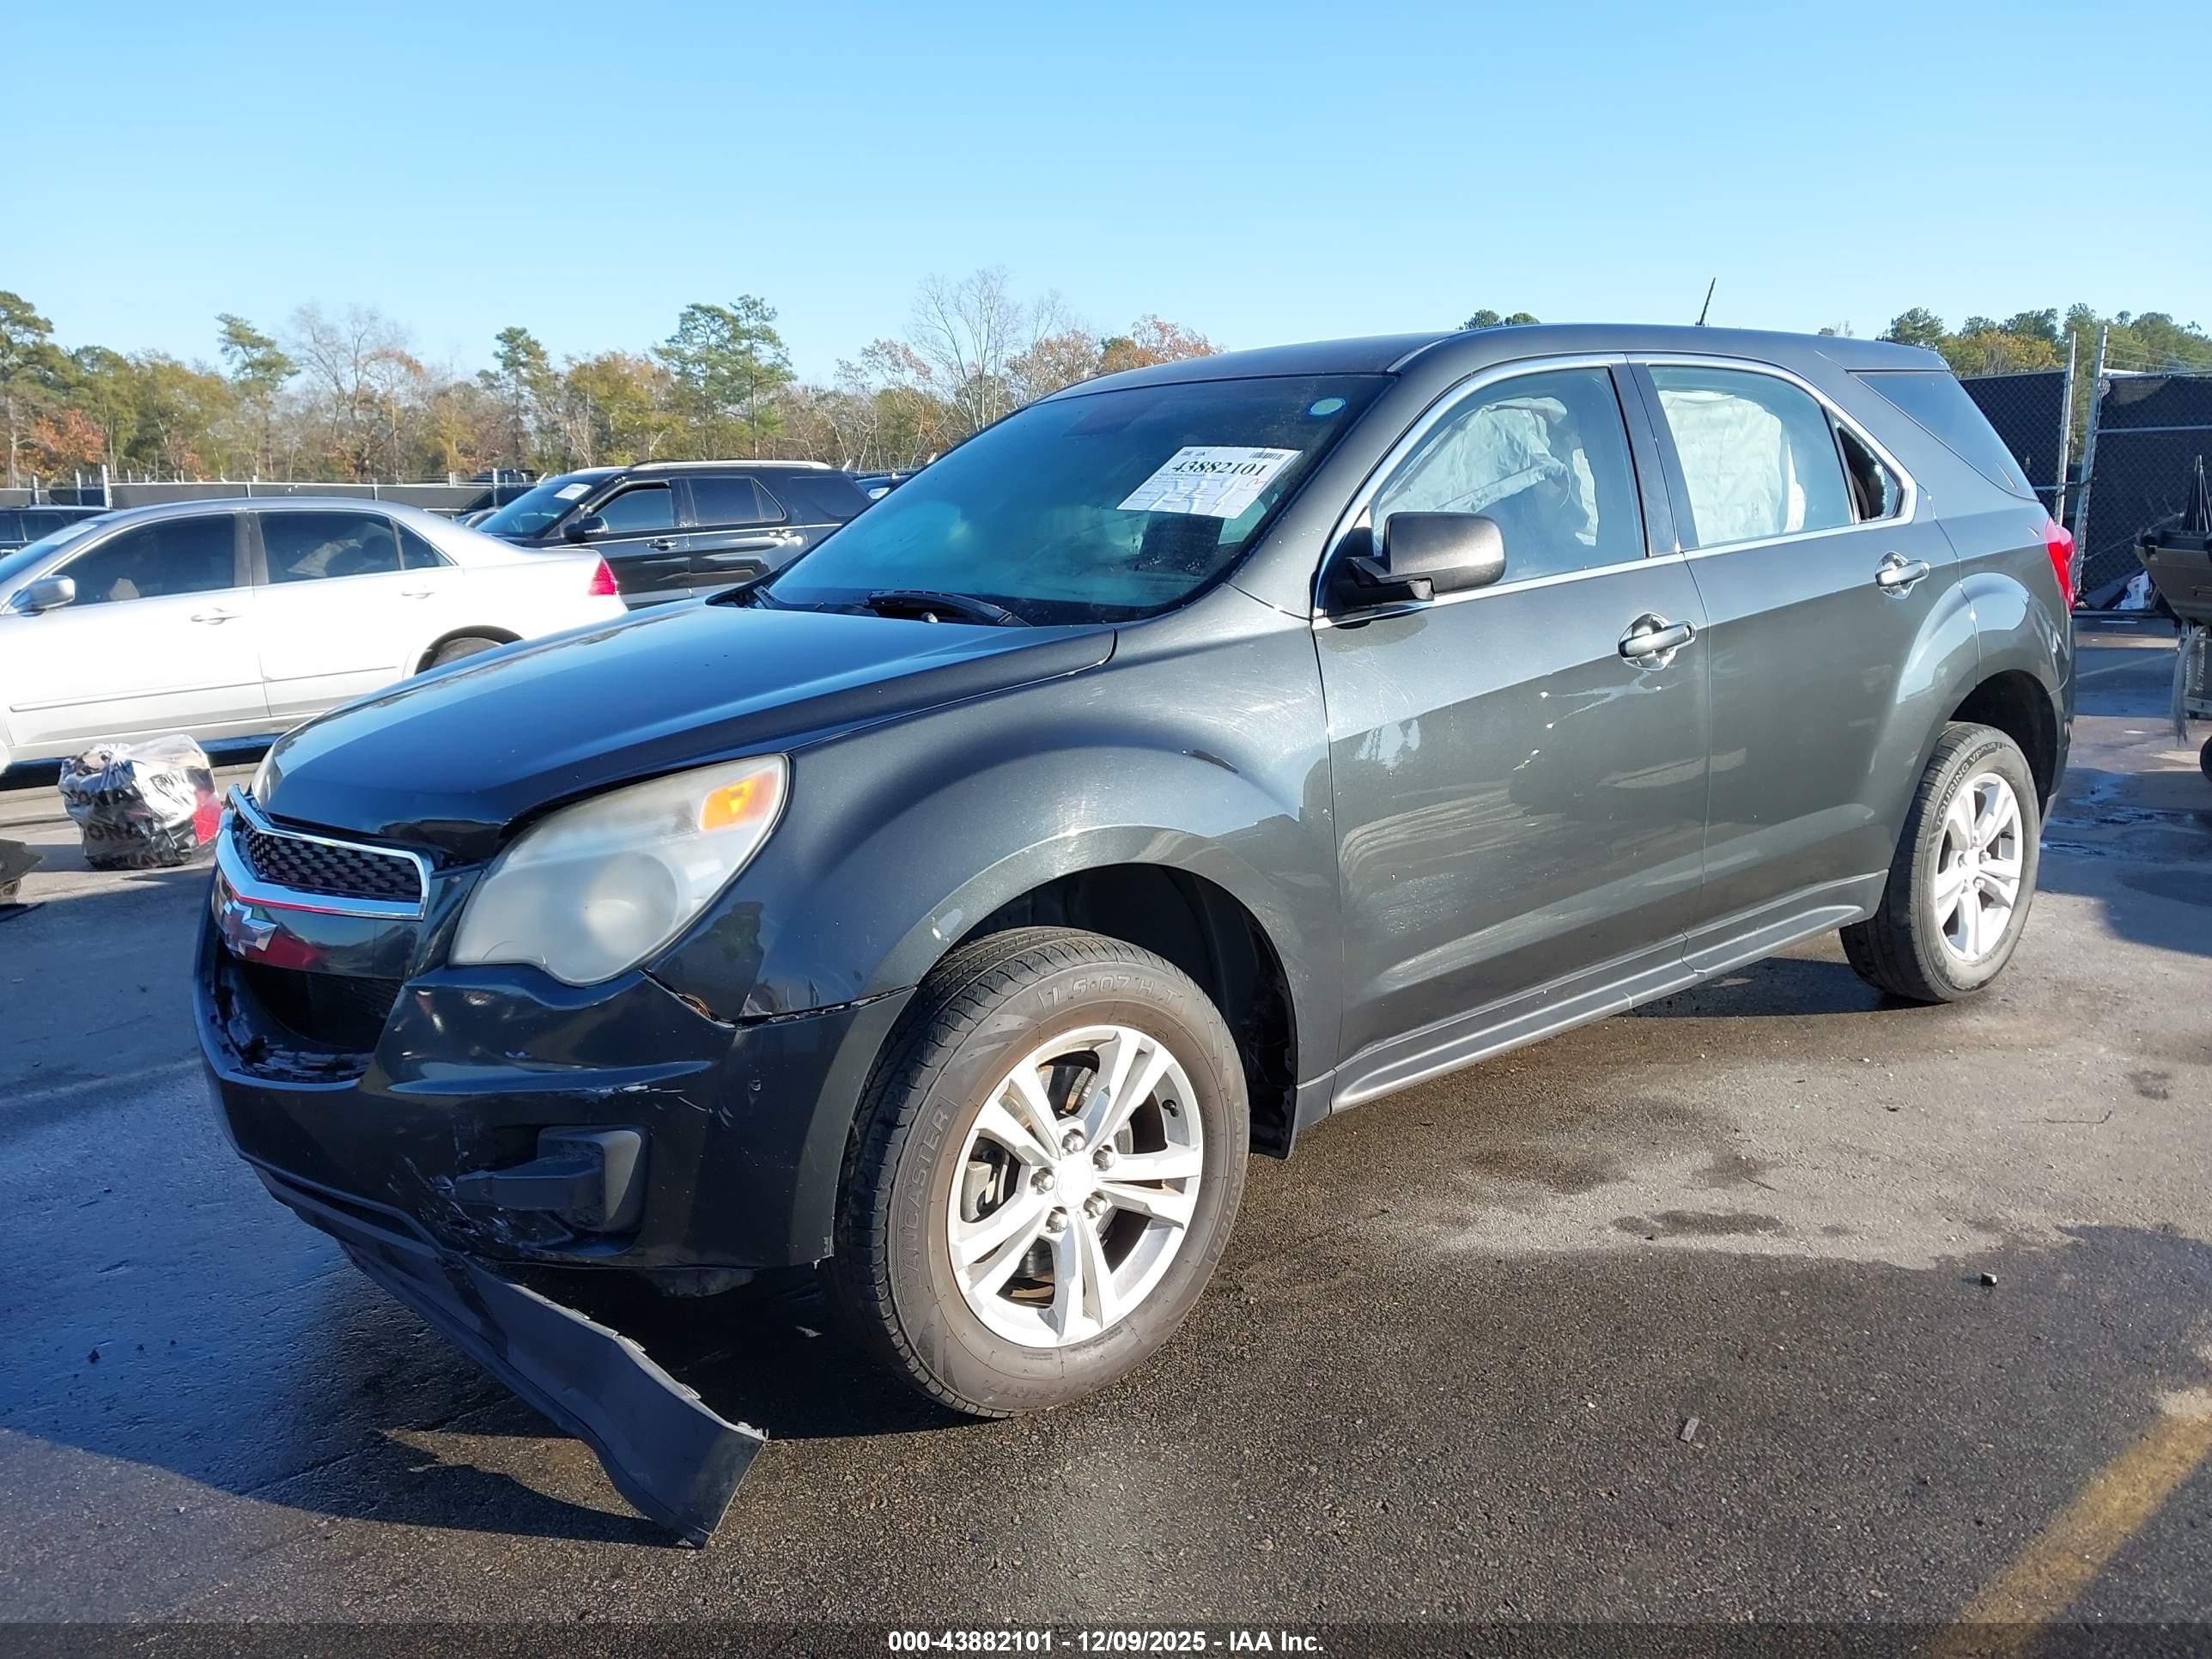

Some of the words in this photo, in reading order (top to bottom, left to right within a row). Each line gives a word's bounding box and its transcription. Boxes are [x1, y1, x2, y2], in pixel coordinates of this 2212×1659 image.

[1172, 460, 1268, 476] 43882101
[1936, 762, 1970, 826] TOURING
[903, 1107, 950, 1289] LANCASTER
